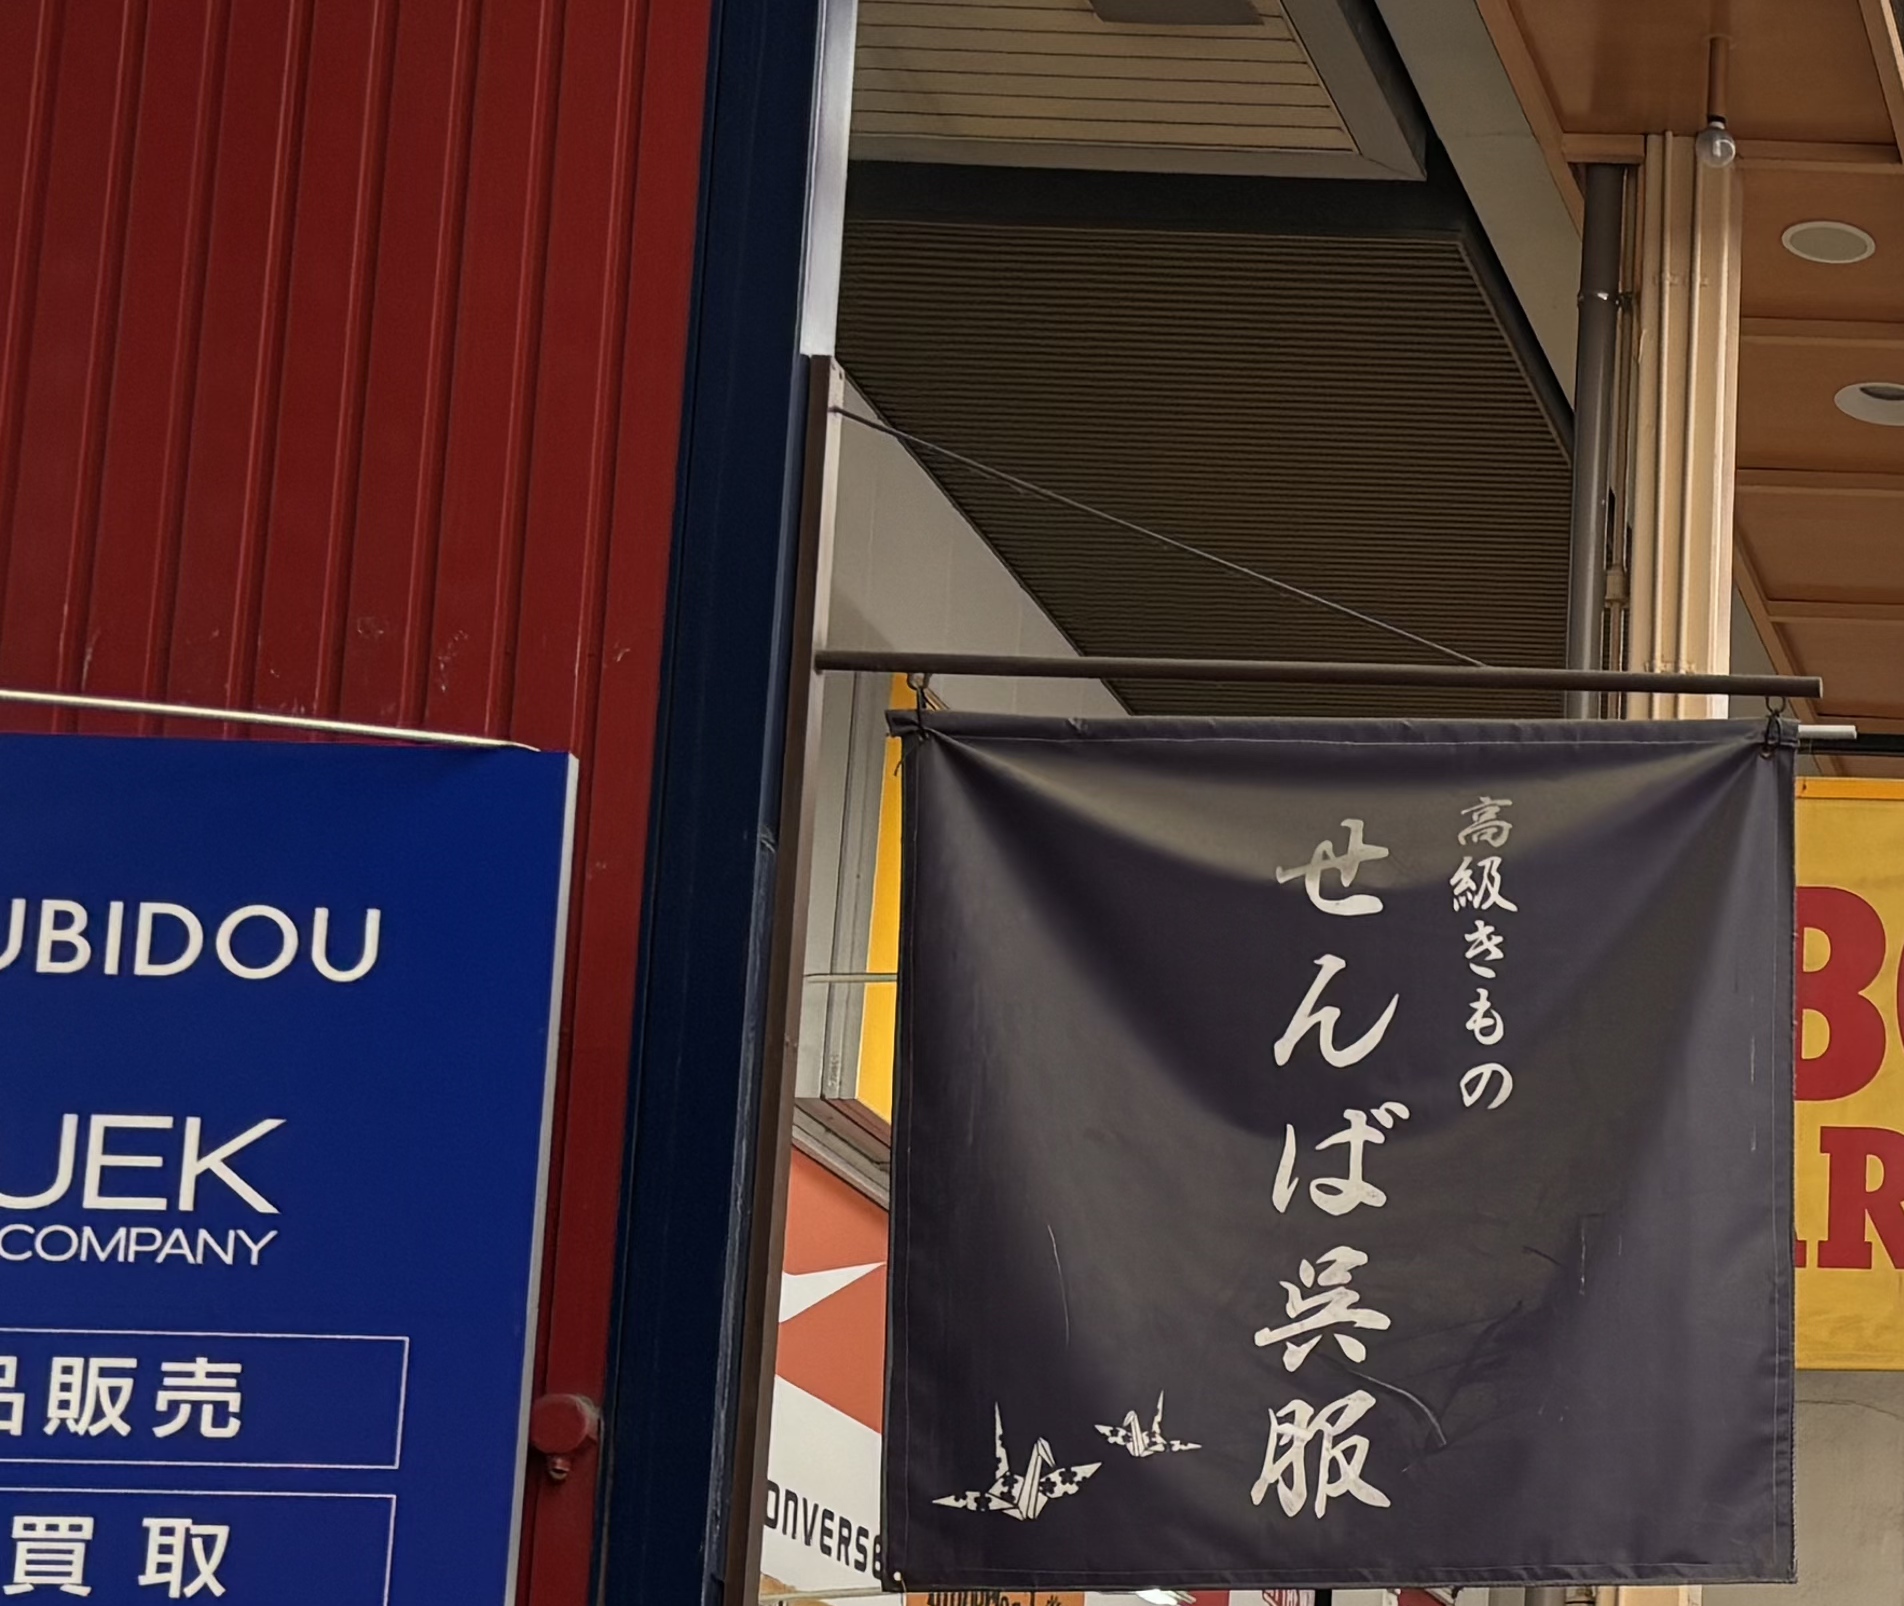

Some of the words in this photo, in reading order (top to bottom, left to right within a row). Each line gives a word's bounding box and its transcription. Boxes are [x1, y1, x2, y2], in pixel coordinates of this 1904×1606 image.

[1448, 795, 1519, 1111] 高級きもの
[1250, 818, 1410, 1517] せんば呉服
[8, 1513, 229, 1600] 買取
